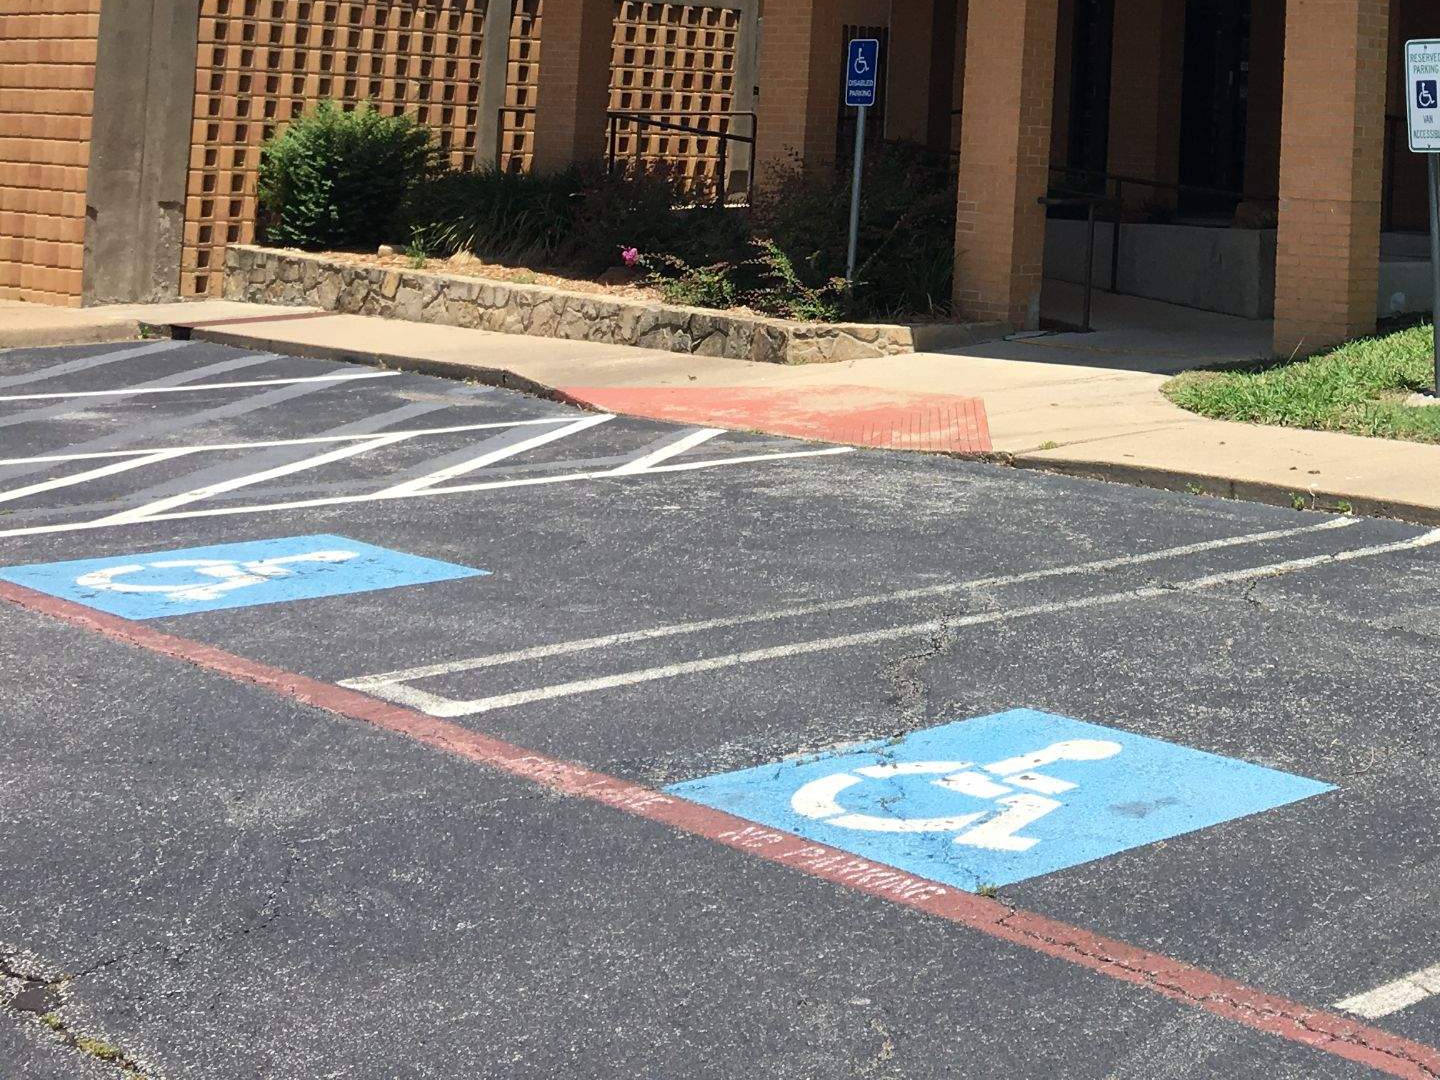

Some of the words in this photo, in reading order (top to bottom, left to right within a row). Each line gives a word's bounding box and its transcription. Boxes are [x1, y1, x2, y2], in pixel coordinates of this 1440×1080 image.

[1412, 64, 1440, 75] PARKING
[848, 79, 874, 87] DISABLED
[848, 89, 872, 97] PARKING
[1422, 114, 1434, 124] VAN
[718, 826, 783, 848] NO
[774, 846, 947, 901] PARKING
